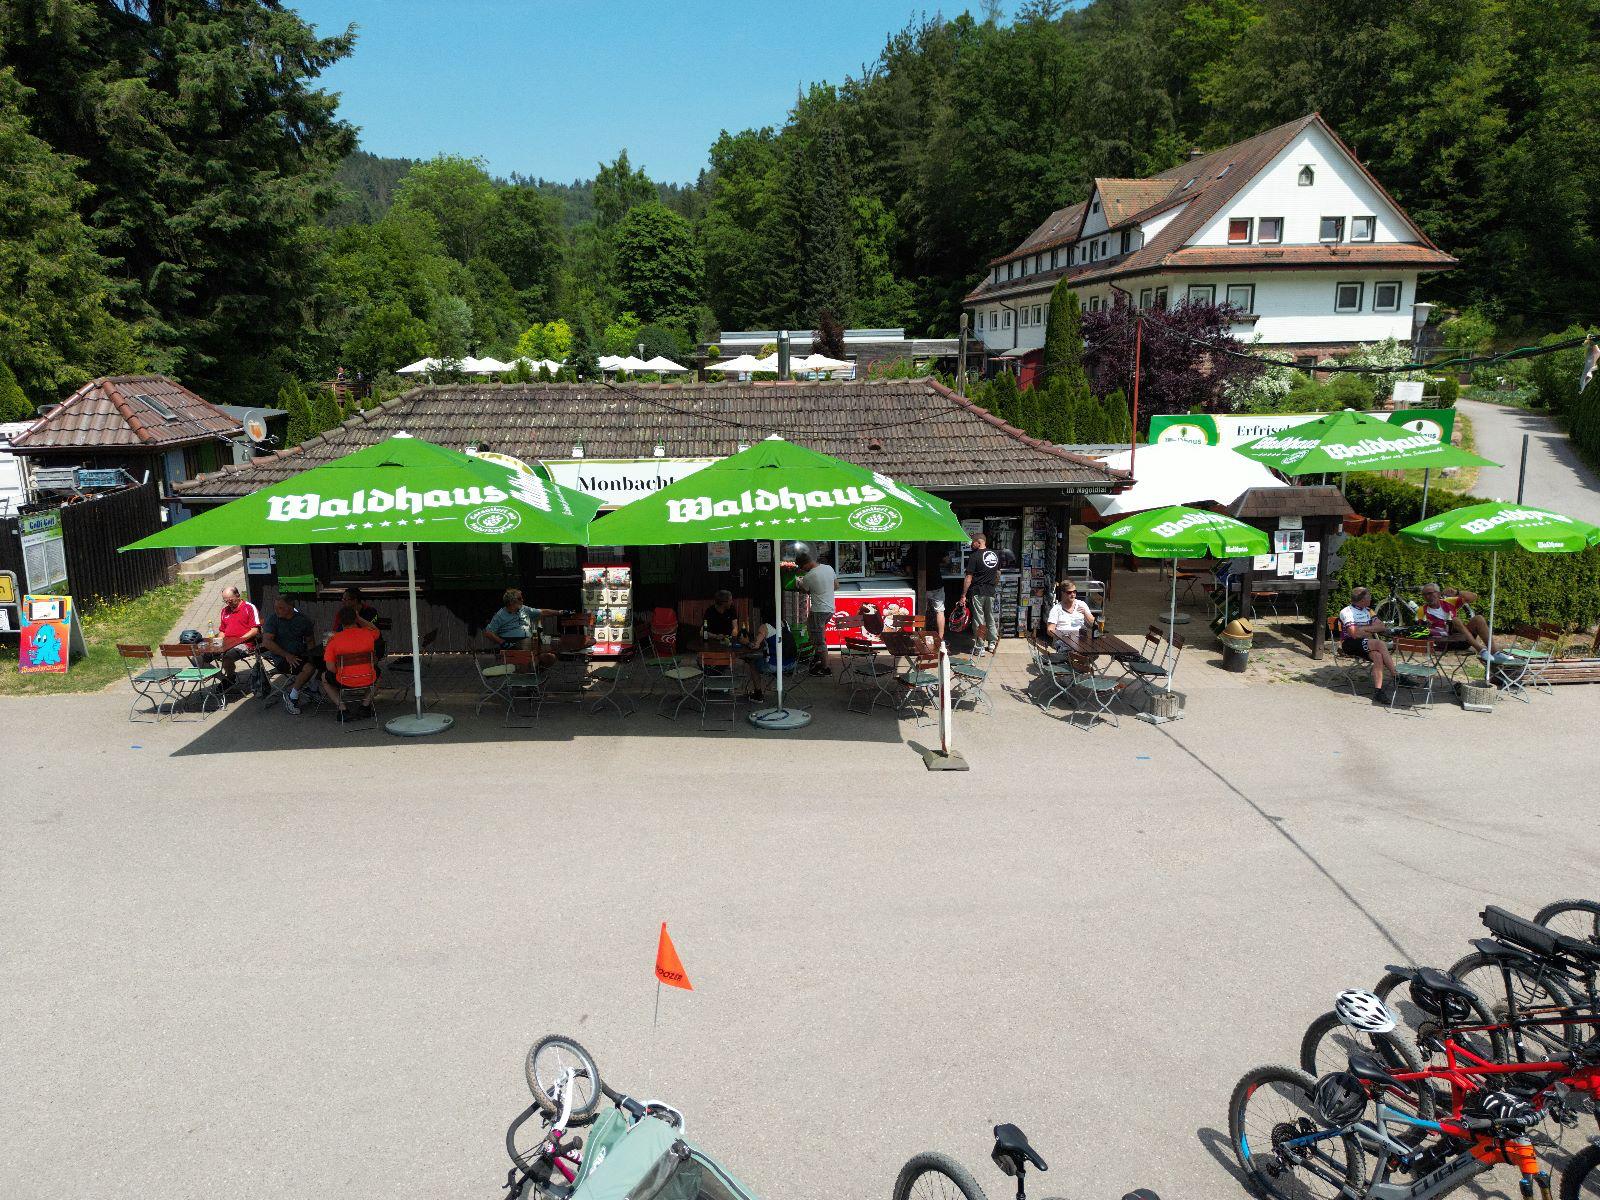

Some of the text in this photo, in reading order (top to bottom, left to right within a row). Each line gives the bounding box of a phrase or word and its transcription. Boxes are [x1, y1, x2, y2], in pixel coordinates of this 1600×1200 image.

[1320, 435, 1440, 460] Waldhaus
[266, 485, 508, 521] Waldhaus
[666, 484, 887, 523] Waldhaus
